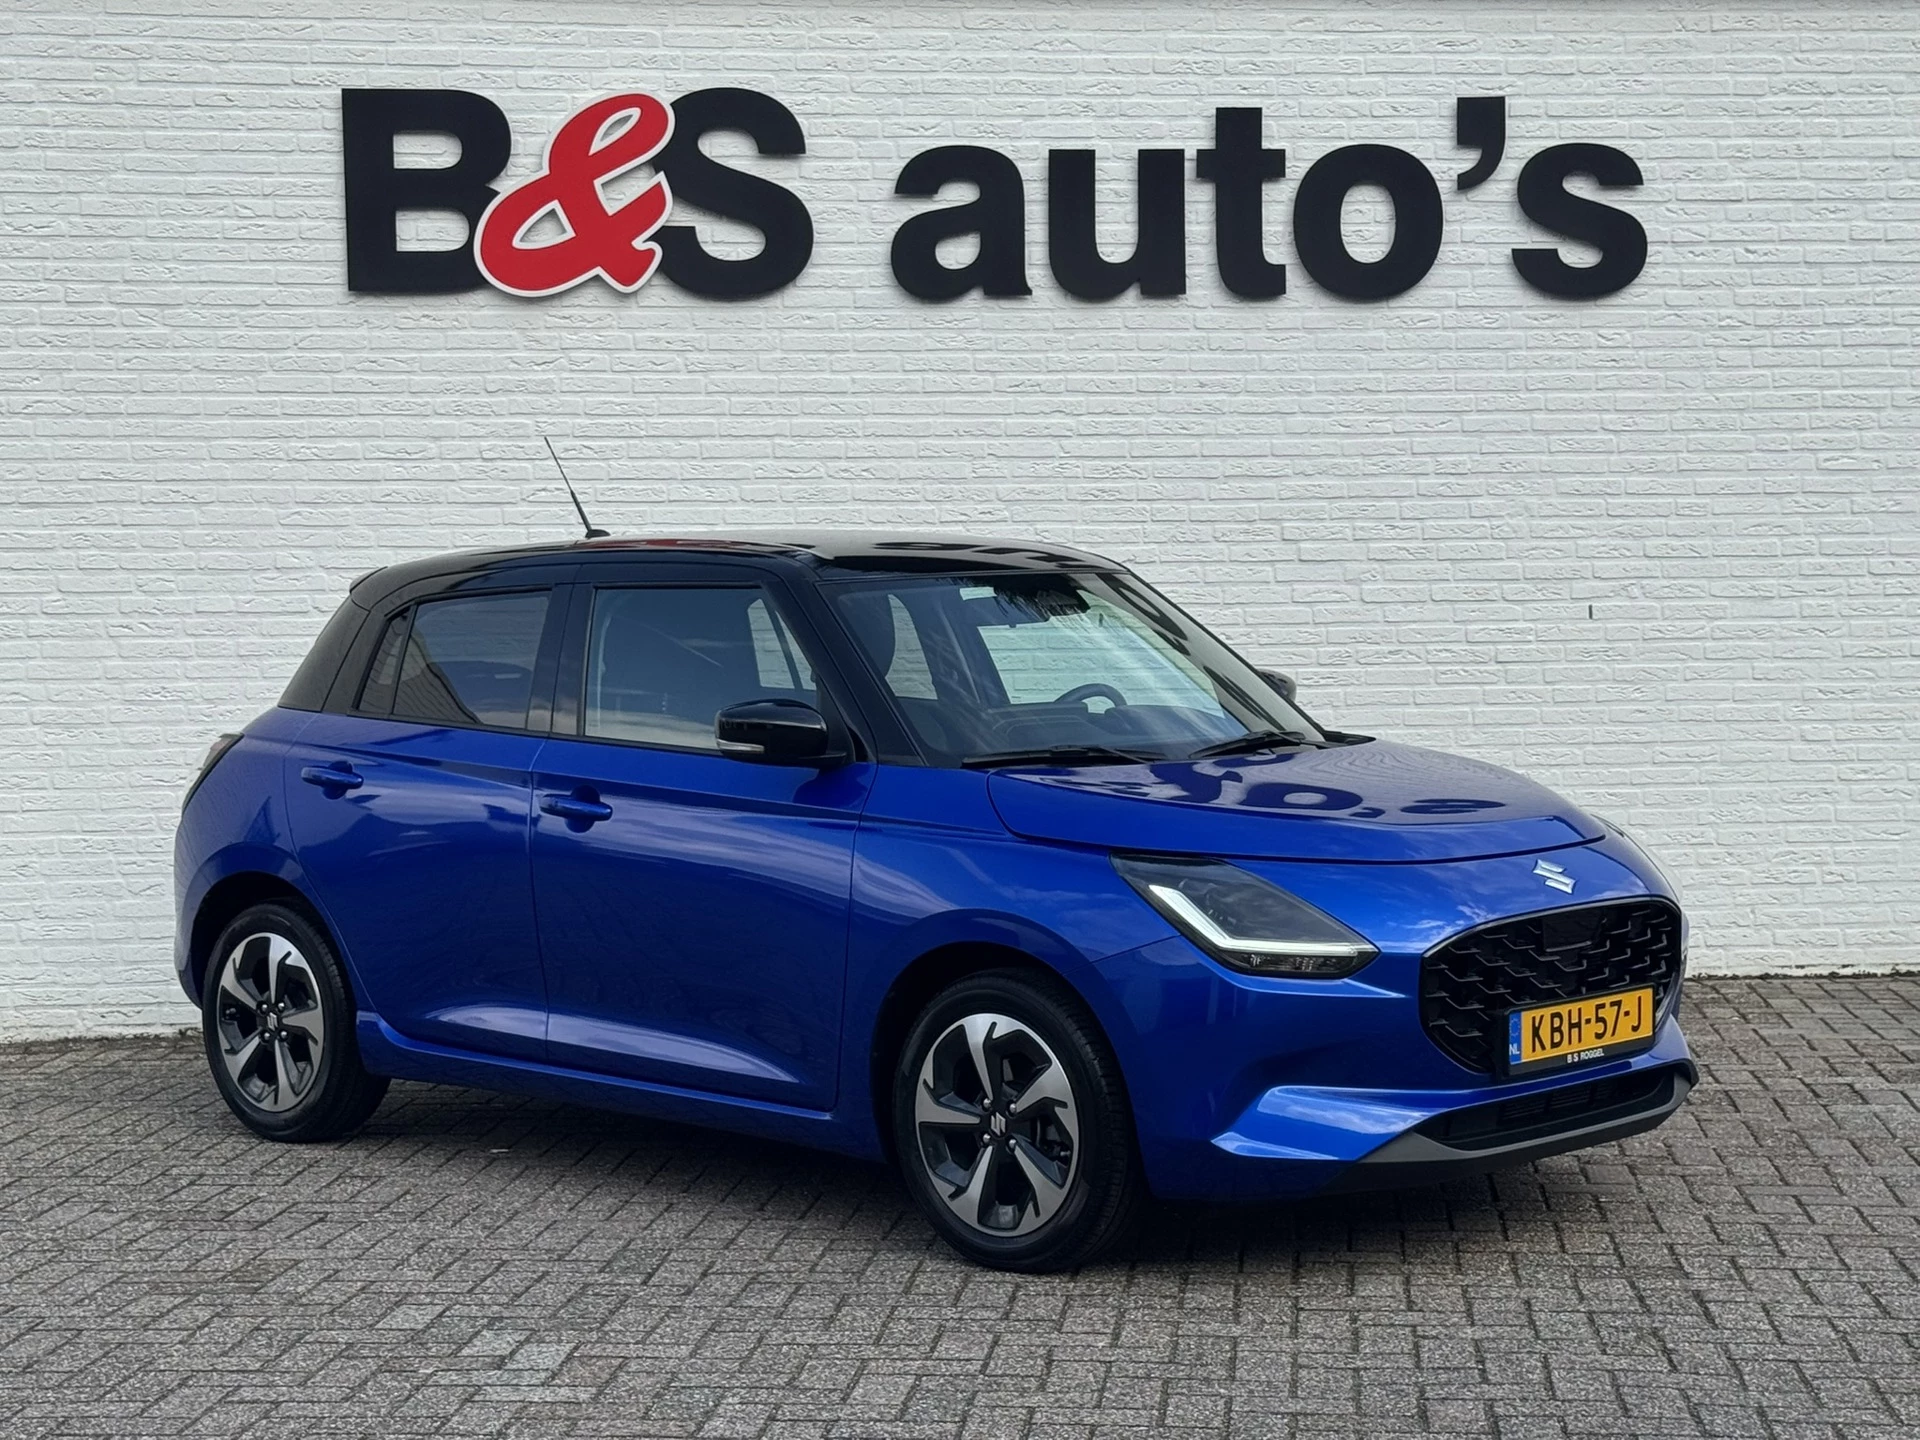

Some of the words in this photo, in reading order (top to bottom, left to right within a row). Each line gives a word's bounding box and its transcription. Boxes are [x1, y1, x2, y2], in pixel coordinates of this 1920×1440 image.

[341, 87, 814, 302] B&S
[890, 95, 1648, 304] auto's
[1531, 995, 1643, 1053] KBH-57-J
[1508, 1043, 1521, 1056] NL
[1580, 1048, 1604, 1060] ROGGEL
